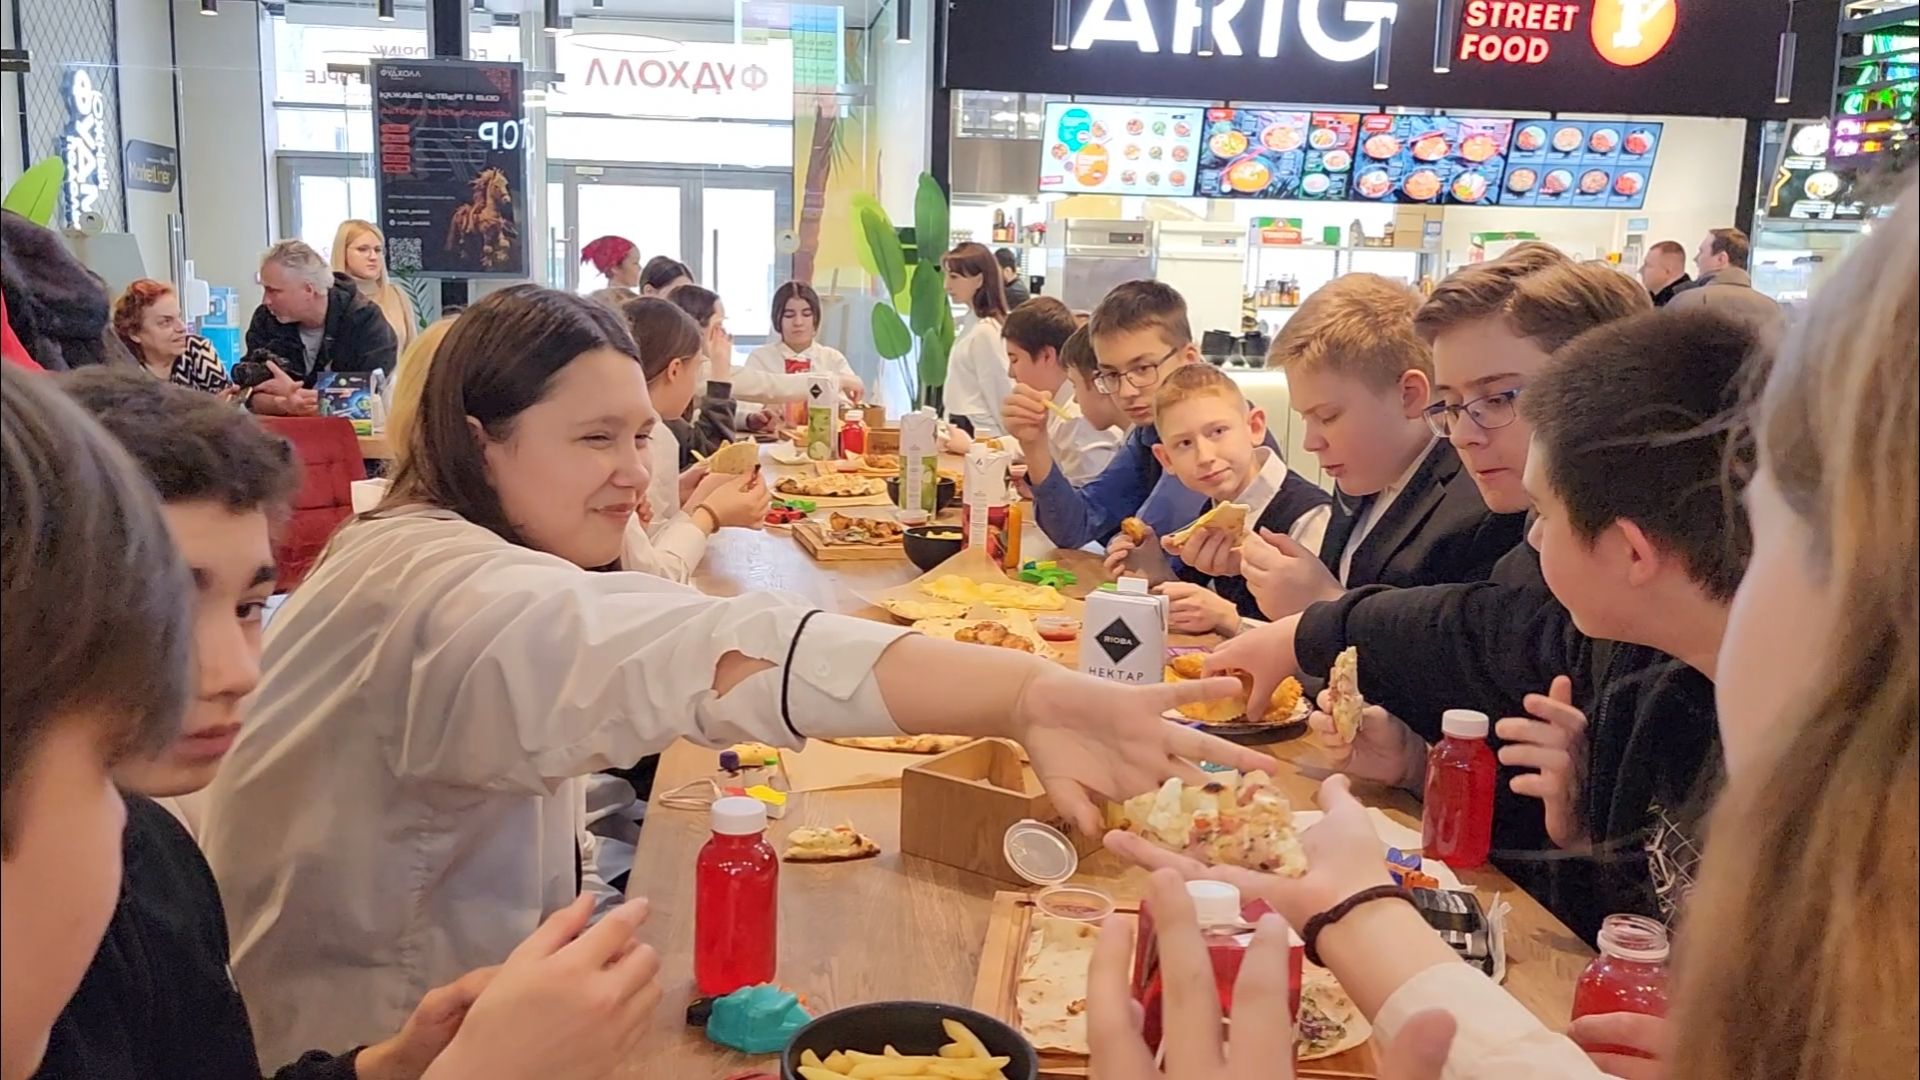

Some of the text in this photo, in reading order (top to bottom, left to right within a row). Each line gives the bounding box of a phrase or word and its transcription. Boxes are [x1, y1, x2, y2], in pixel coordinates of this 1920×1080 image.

[1070, 0, 1398, 62] ARIG
[1466, 1, 1579, 31] STREET
[1460, 33, 1550, 64] FOOD
[1103, 635, 1133, 645] RIOBA
[1088, 666, 1144, 681] НЕКТАР
